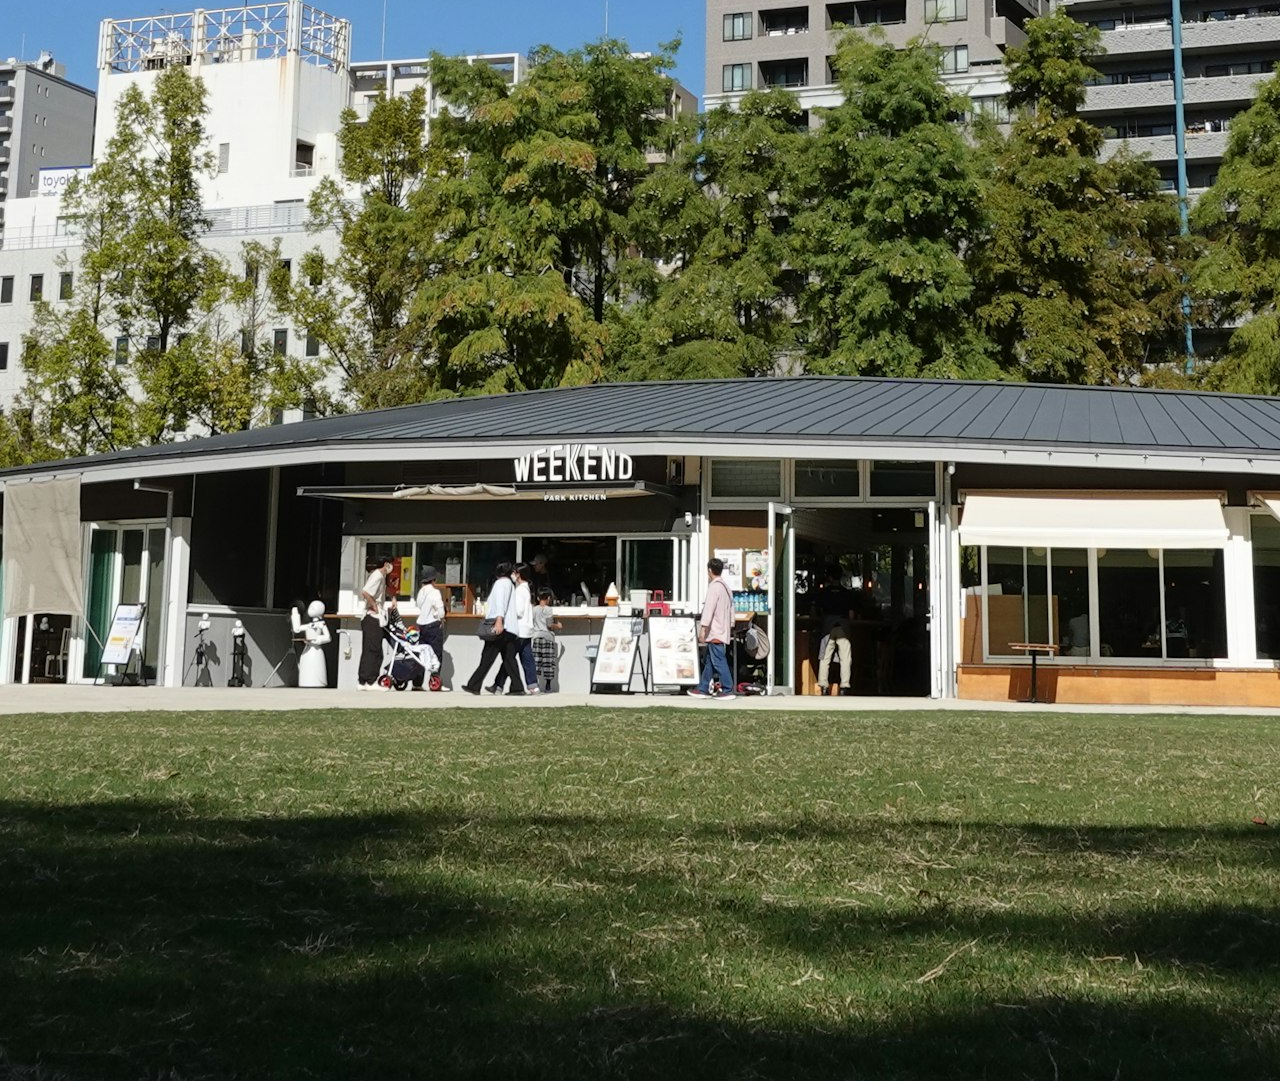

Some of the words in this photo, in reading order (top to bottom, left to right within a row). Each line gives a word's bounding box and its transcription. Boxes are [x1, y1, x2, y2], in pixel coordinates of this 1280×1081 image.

[514, 443, 633, 482] WEEKEND
[543, 494, 566, 502] PARK
[569, 493, 607, 501] KITCHEN
